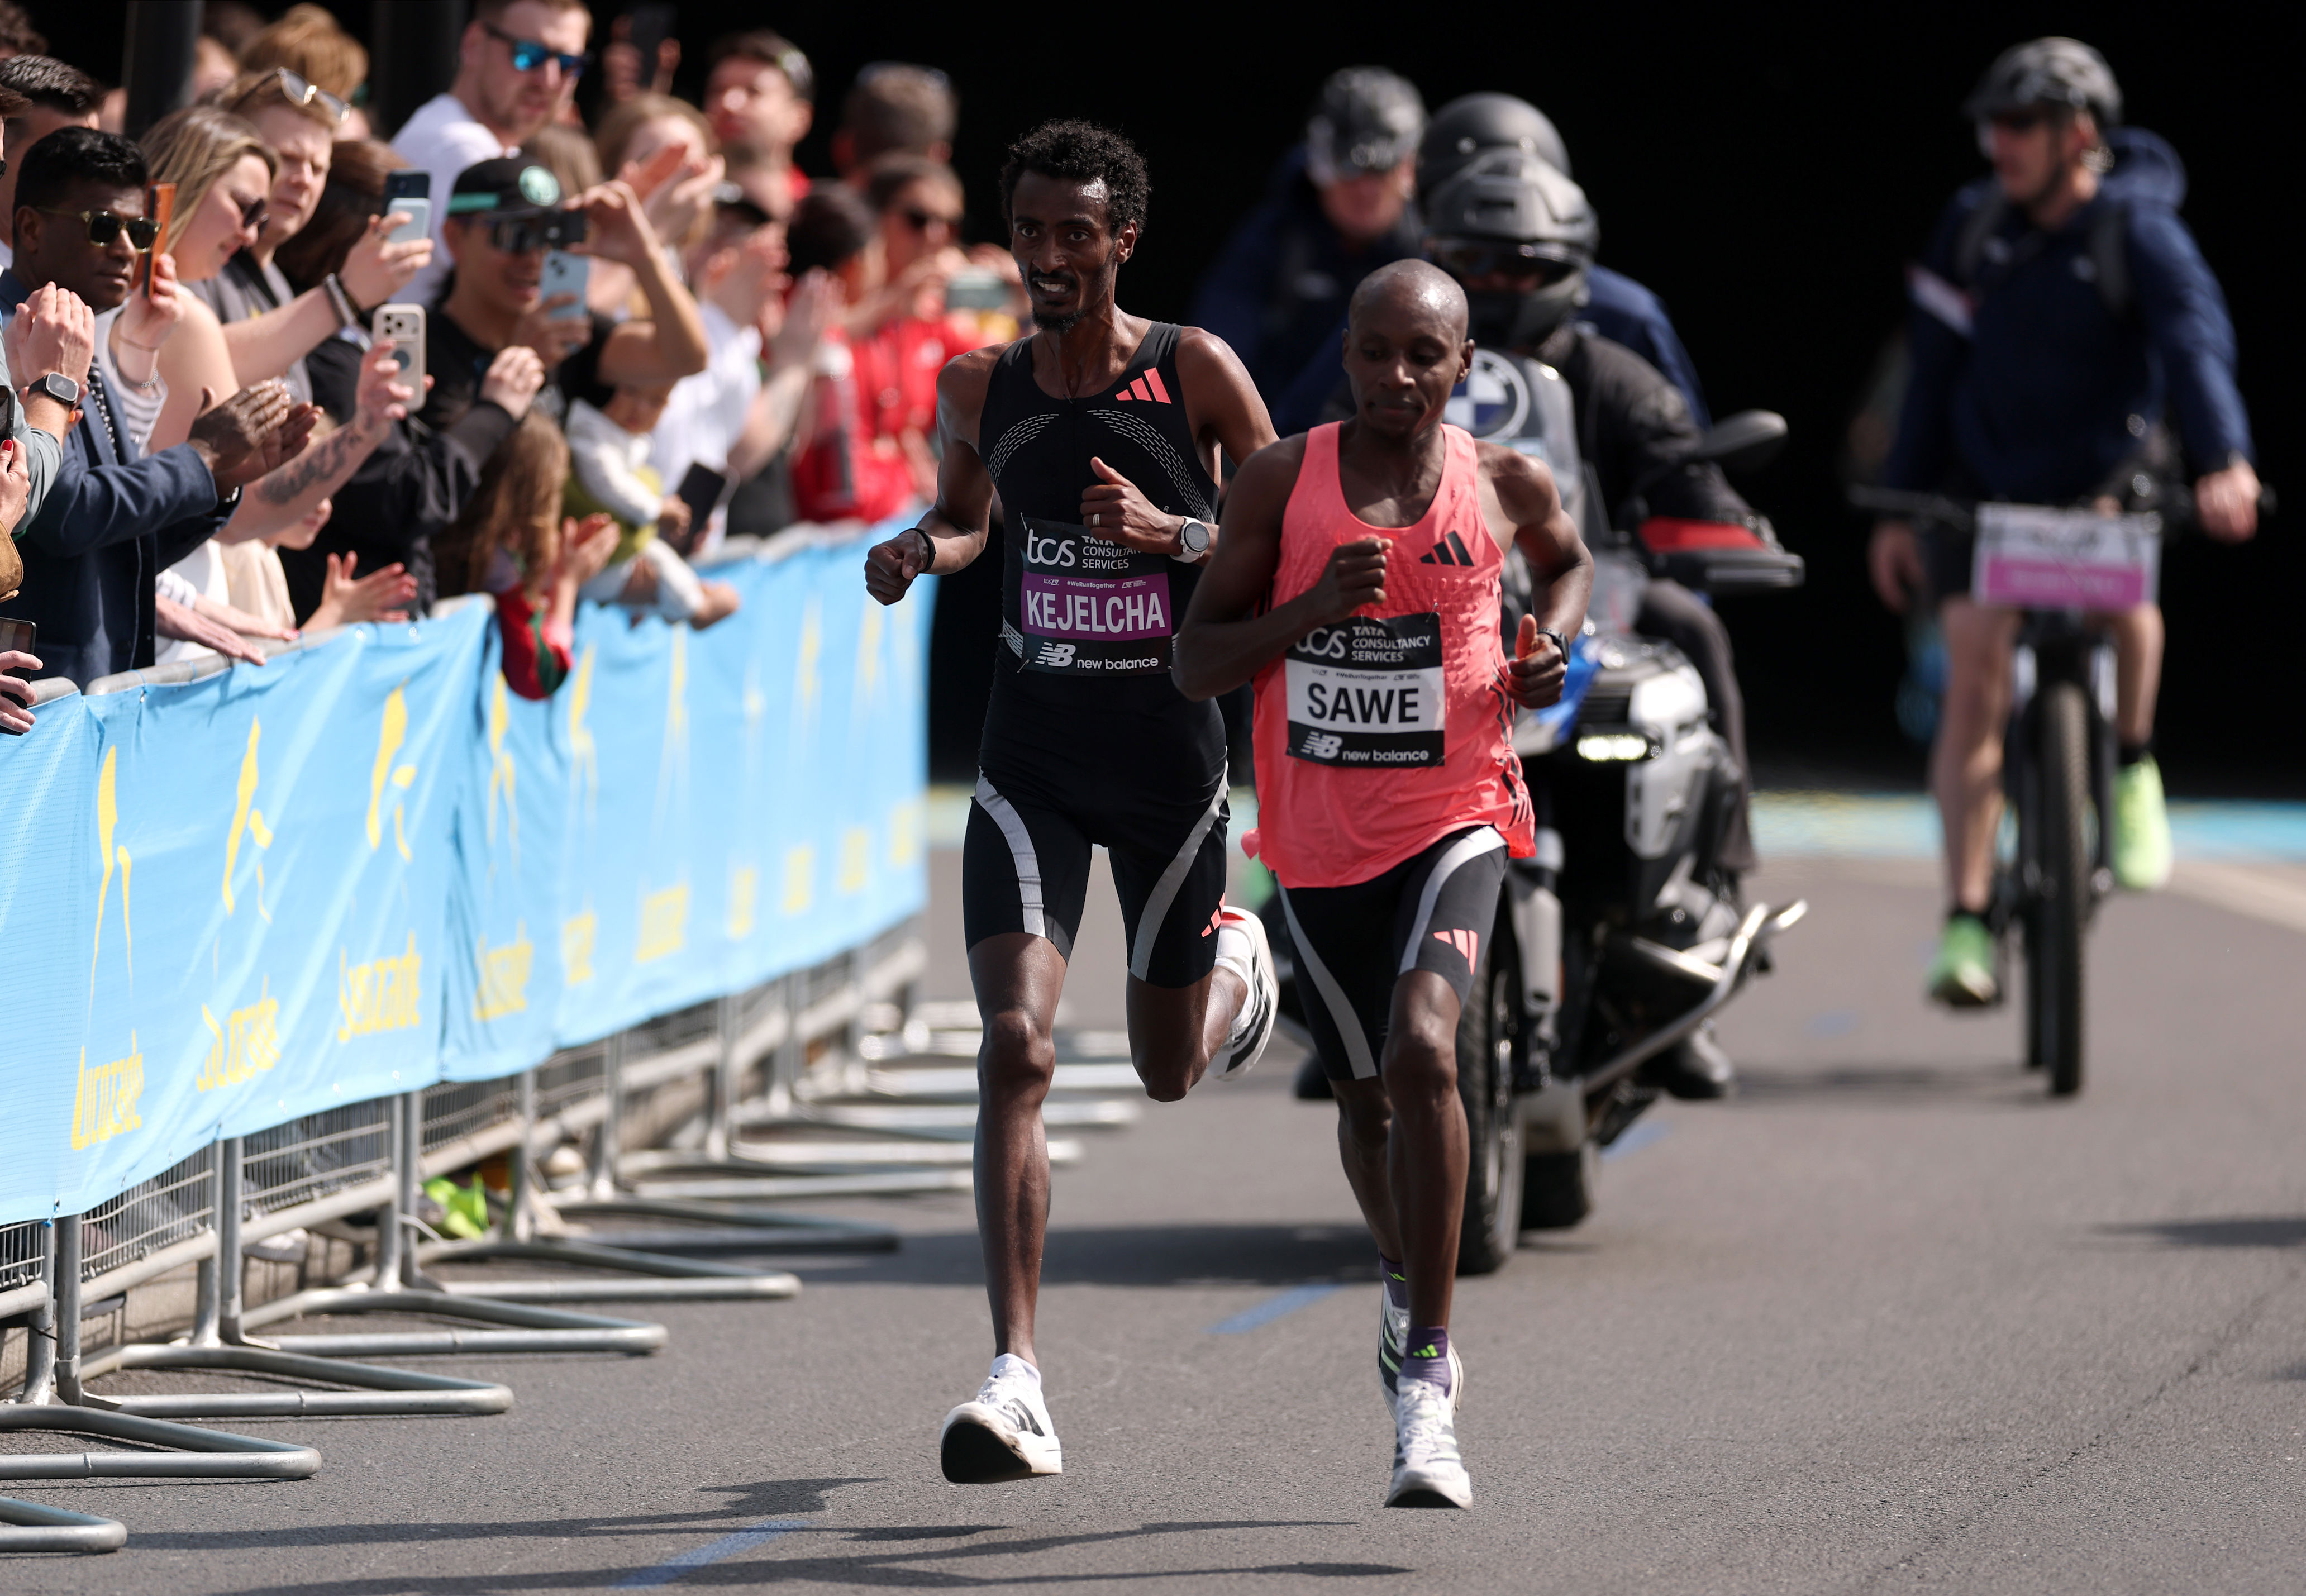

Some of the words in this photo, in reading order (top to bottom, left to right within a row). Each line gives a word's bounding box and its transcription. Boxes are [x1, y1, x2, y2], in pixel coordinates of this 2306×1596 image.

[1027, 528, 1075, 567] tcs
[1082, 545, 1141, 558] CONSULTA
[1081, 559, 1129, 570] SERVICES
[1067, 580, 1116, 589] #WeRunTogether
[1026, 590, 1165, 633] KEJELCHA
[1352, 626, 1386, 637] TATA
[1352, 635, 1431, 650] CONSULTANCY
[1351, 651, 1404, 662] SERVICES
[1077, 659, 1102, 669] new
[1105, 657, 1159, 670] balance
[1307, 683, 1419, 724] SAWE
[1342, 750, 1370, 761] new
[1373, 749, 1429, 762] balance
